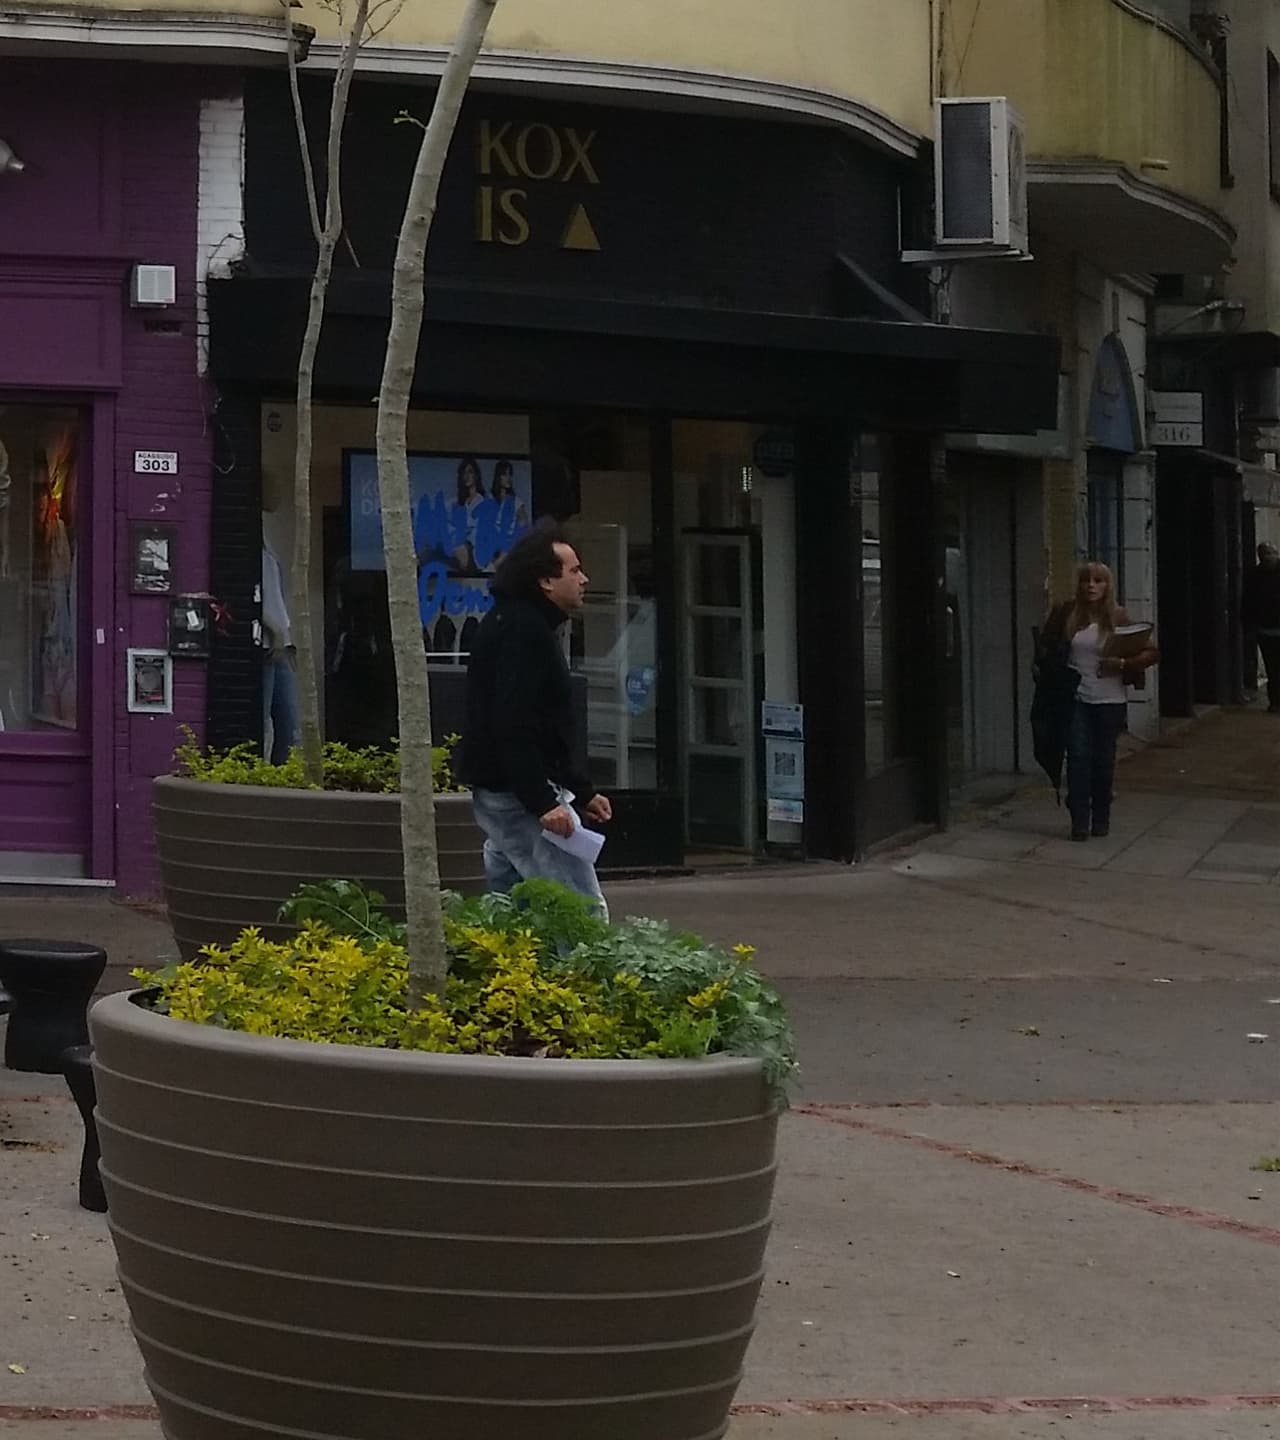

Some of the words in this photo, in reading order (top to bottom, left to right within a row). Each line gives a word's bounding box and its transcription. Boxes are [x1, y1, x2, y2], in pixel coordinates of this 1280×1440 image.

[480, 120, 600, 184] KOX
[480, 186, 530, 246] IS
[142, 459, 170, 472] 303
